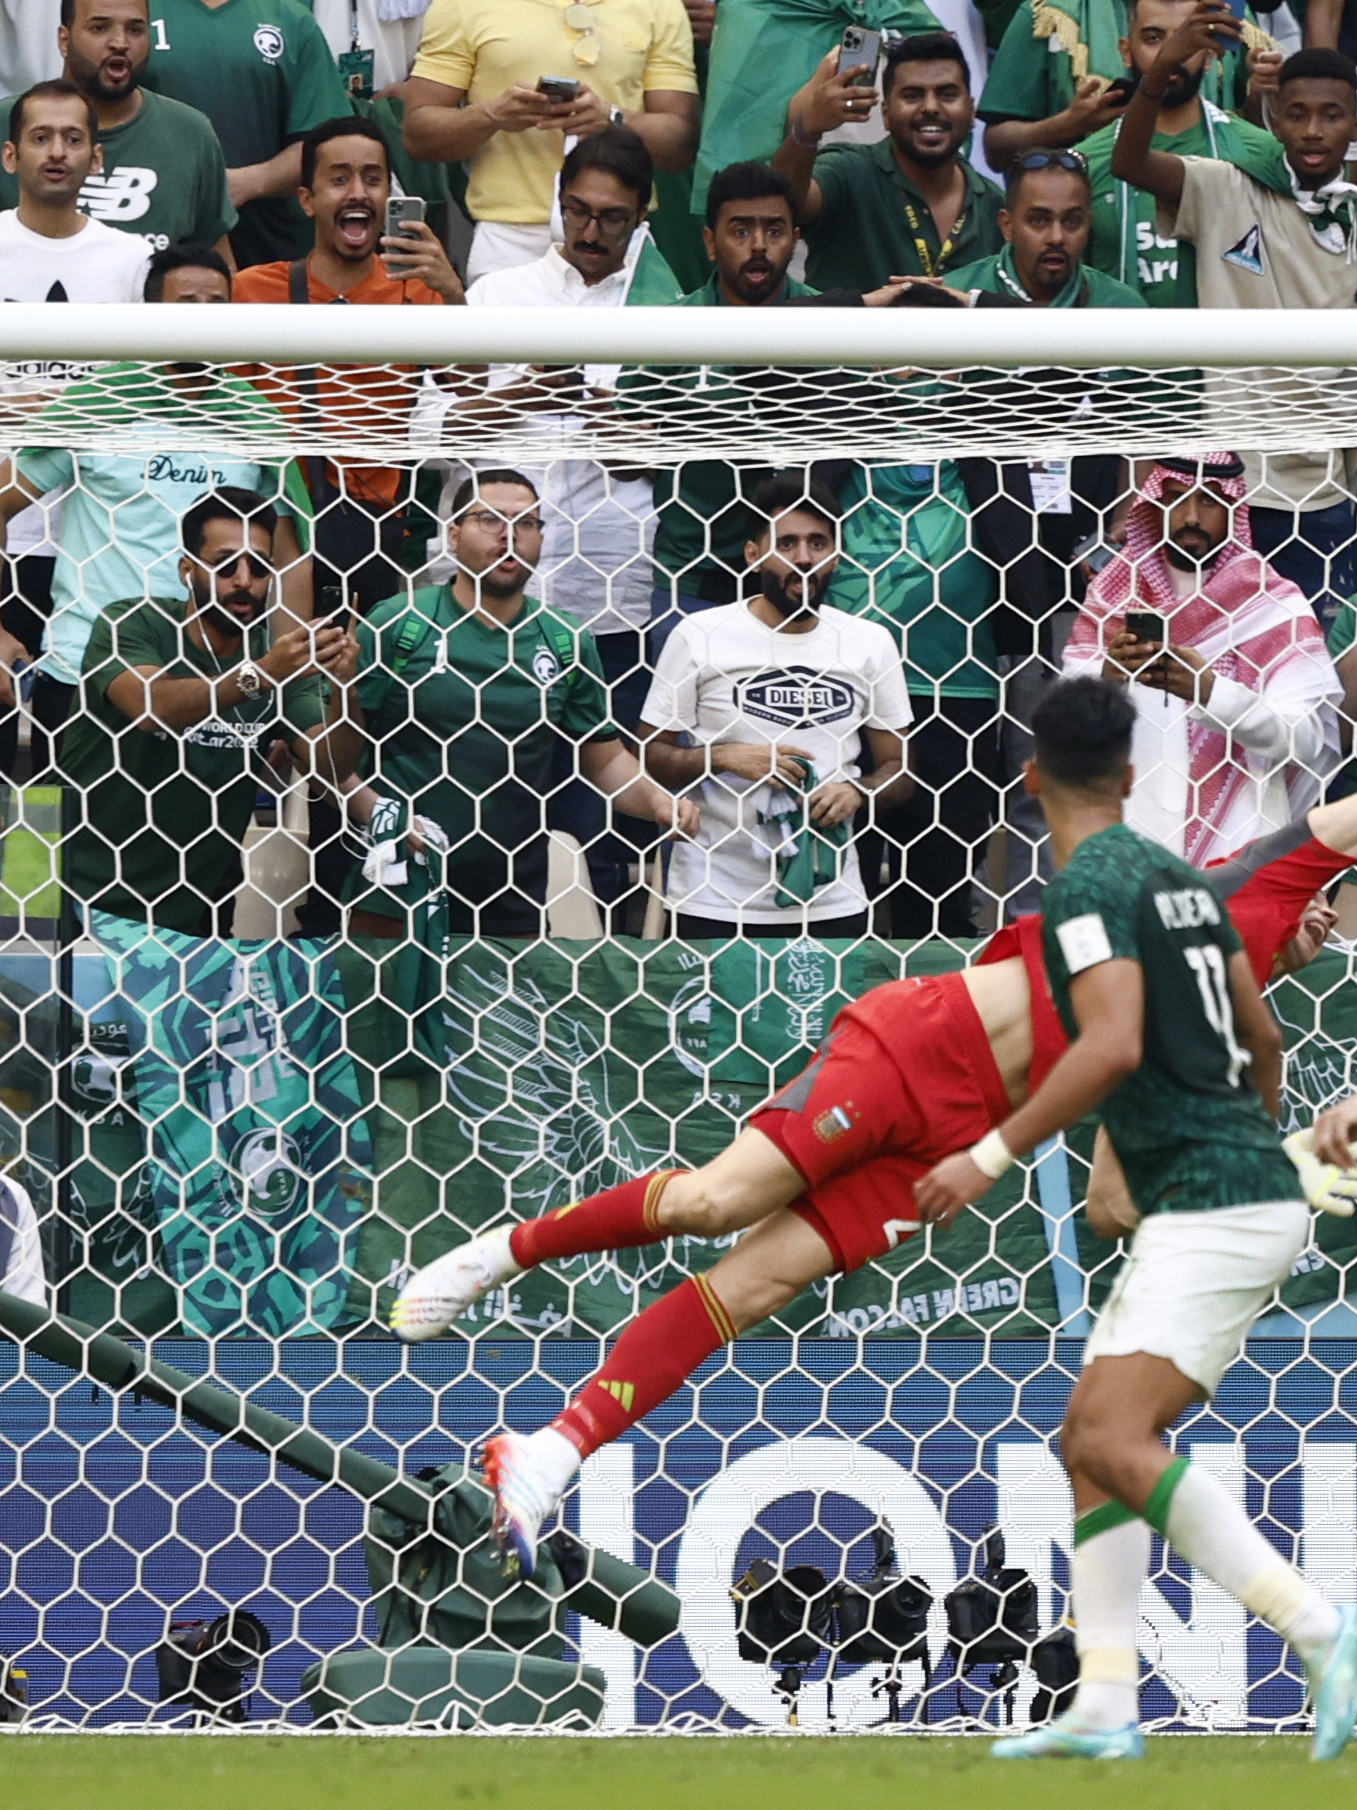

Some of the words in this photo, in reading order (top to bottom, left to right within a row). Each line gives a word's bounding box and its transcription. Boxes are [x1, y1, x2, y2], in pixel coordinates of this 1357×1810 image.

[150, 19, 171, 50] 1
[140, 454, 227, 485] Denim
[769, 689, 834, 709] DIESEL
